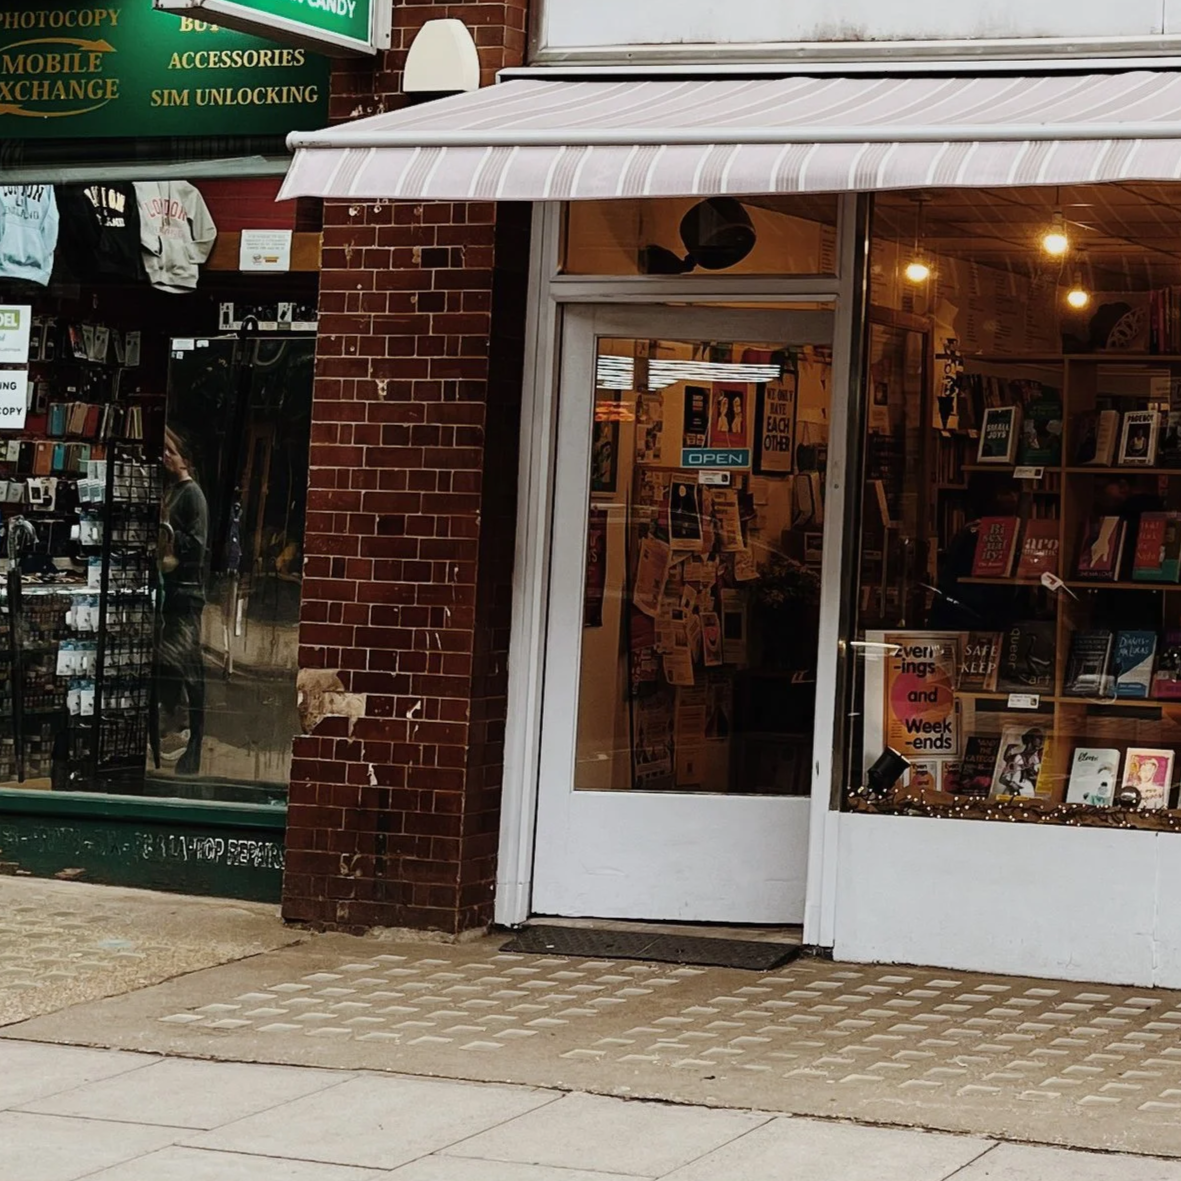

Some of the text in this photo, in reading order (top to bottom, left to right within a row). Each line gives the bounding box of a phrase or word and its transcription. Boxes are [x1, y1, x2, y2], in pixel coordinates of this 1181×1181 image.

[1, 52, 103, 76] MOBILE
[167, 48, 306, 71] ACCESSORIES
[150, 85, 319, 107] SIM UNLOCKING
[766, 416, 790, 434] EACH
[764, 434, 791, 452] OTHER
[688, 453, 743, 465] OPEN
[965, 643, 999, 657] SAFE
[1007, 627, 1021, 670] queer
[893, 658, 936, 678] -ings
[961, 661, 997, 675] KEEP
[1028, 674, 1053, 686] art
[907, 686, 938, 703] and
[905, 717, 953, 734] Week
[905, 733, 953, 750] -ends
